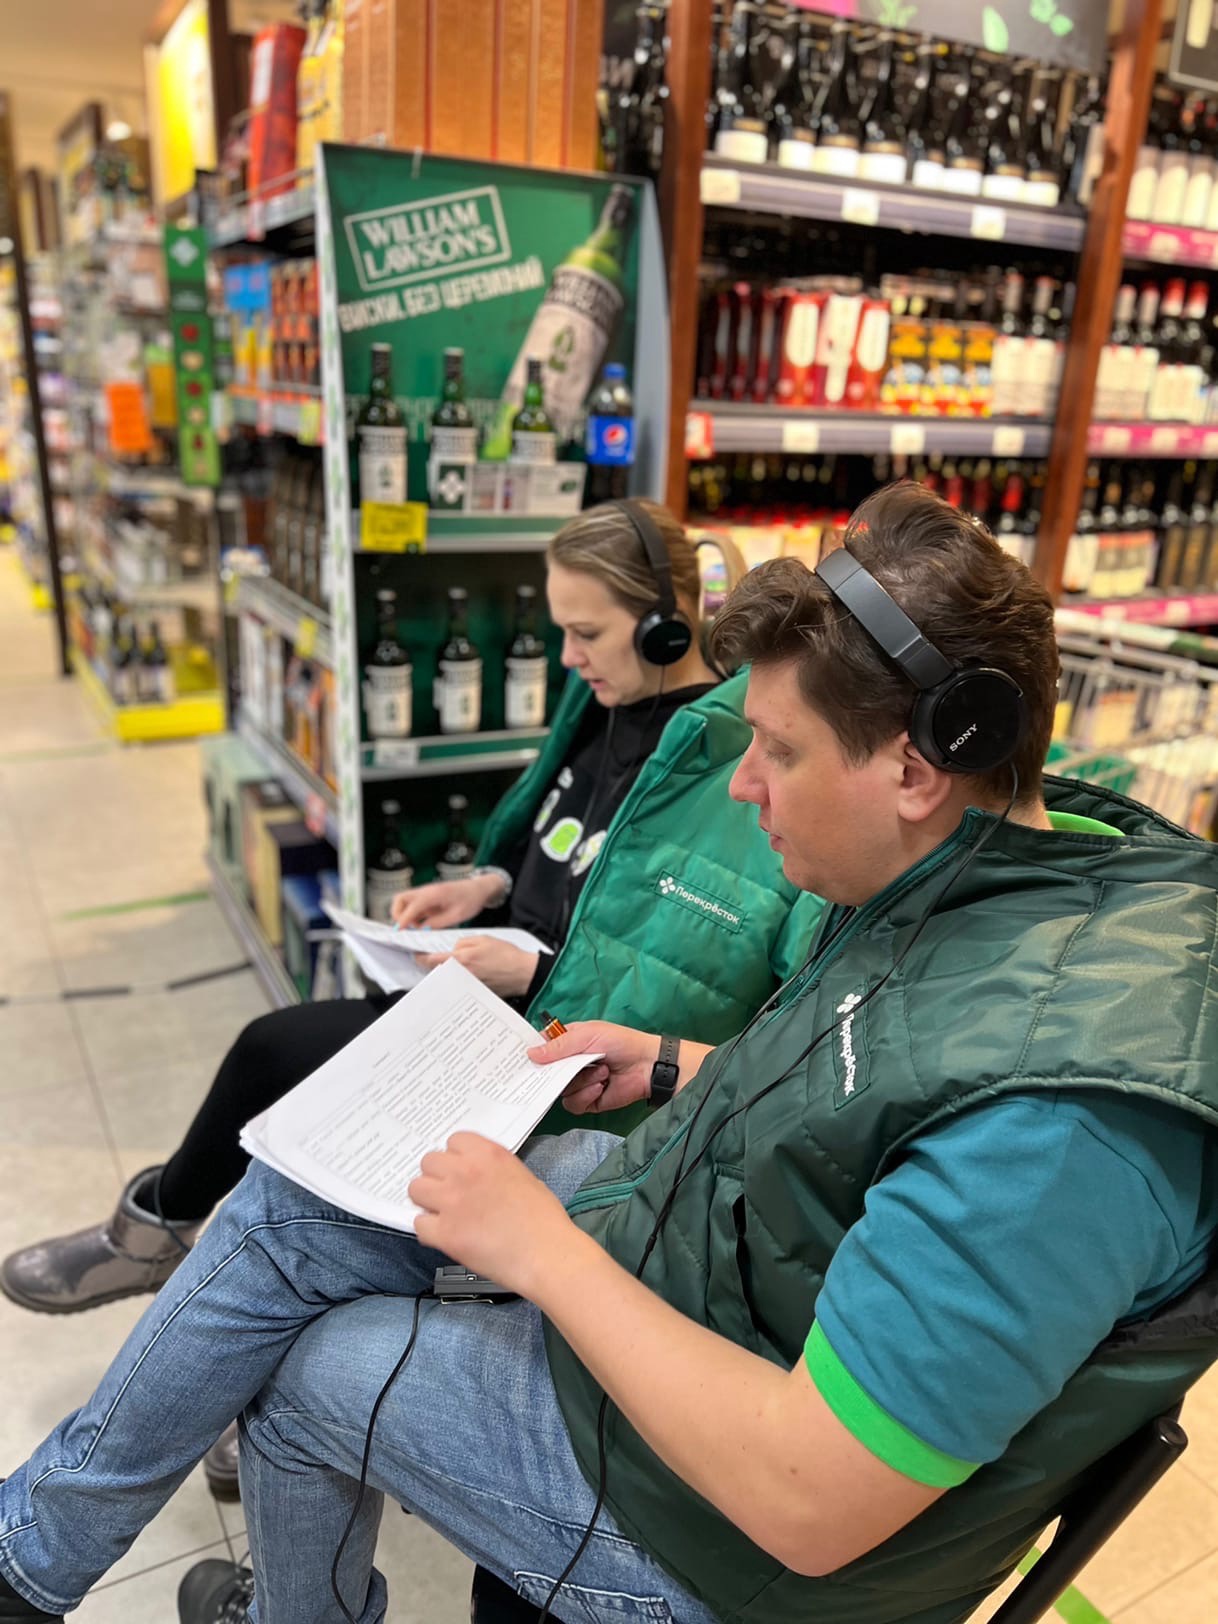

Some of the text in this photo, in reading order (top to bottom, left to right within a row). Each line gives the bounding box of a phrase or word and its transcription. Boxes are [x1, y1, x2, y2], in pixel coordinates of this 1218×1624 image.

[360, 200, 480, 248] WILLIAM
[363, 224, 497, 280] LAWSON'S
[402, 283, 442, 318] БЕЗ
[949, 723, 978, 752] SONY
